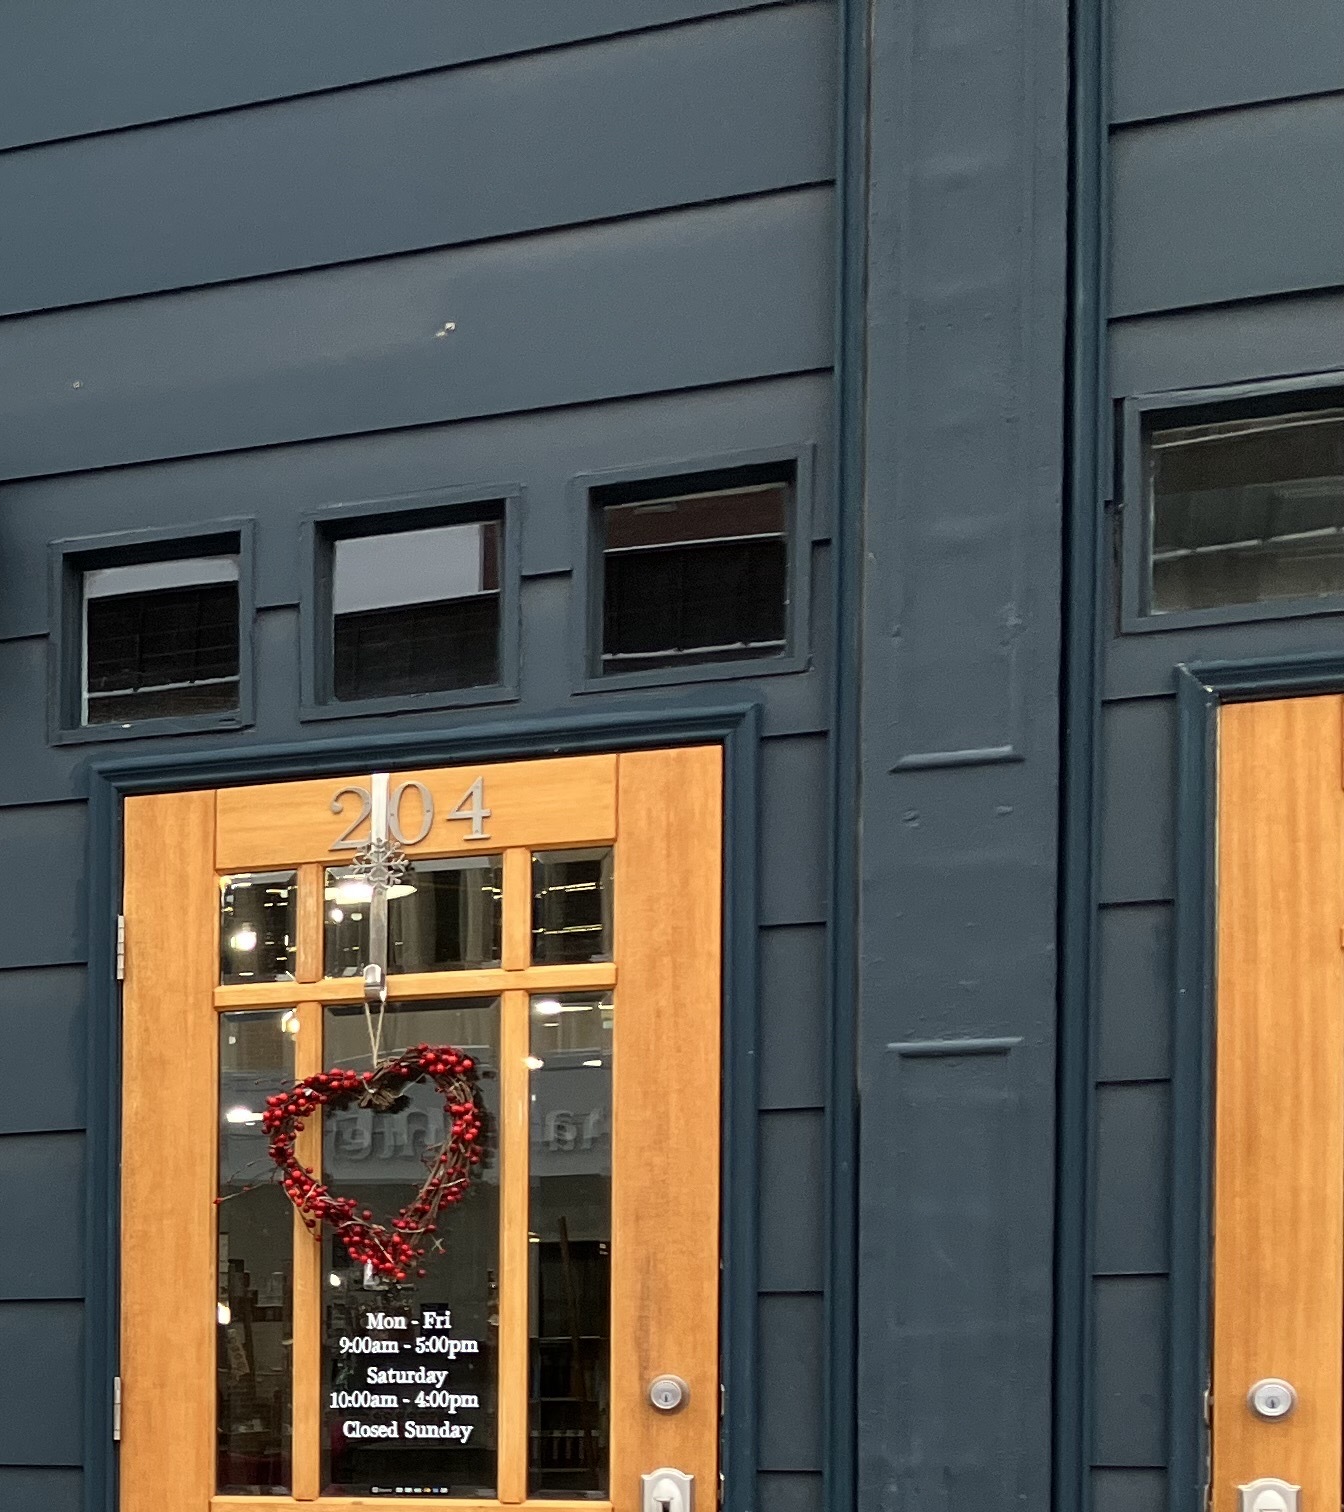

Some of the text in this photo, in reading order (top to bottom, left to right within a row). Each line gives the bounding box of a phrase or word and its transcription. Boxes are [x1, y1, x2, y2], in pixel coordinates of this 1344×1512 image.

[328, 775, 492, 851] 204
[366, 1312, 407, 1330] Mon
[422, 1311, 452, 1329] Fri
[339, 1336, 400, 1354] 9:00am
[415, 1335, 479, 1360] 5:00pm
[366, 1366, 449, 1389] Saturday
[330, 1390, 399, 1409] 10:00am
[414, 1390, 480, 1414] 4:00pm
[342, 1420, 474, 1444] Closed Sunday
